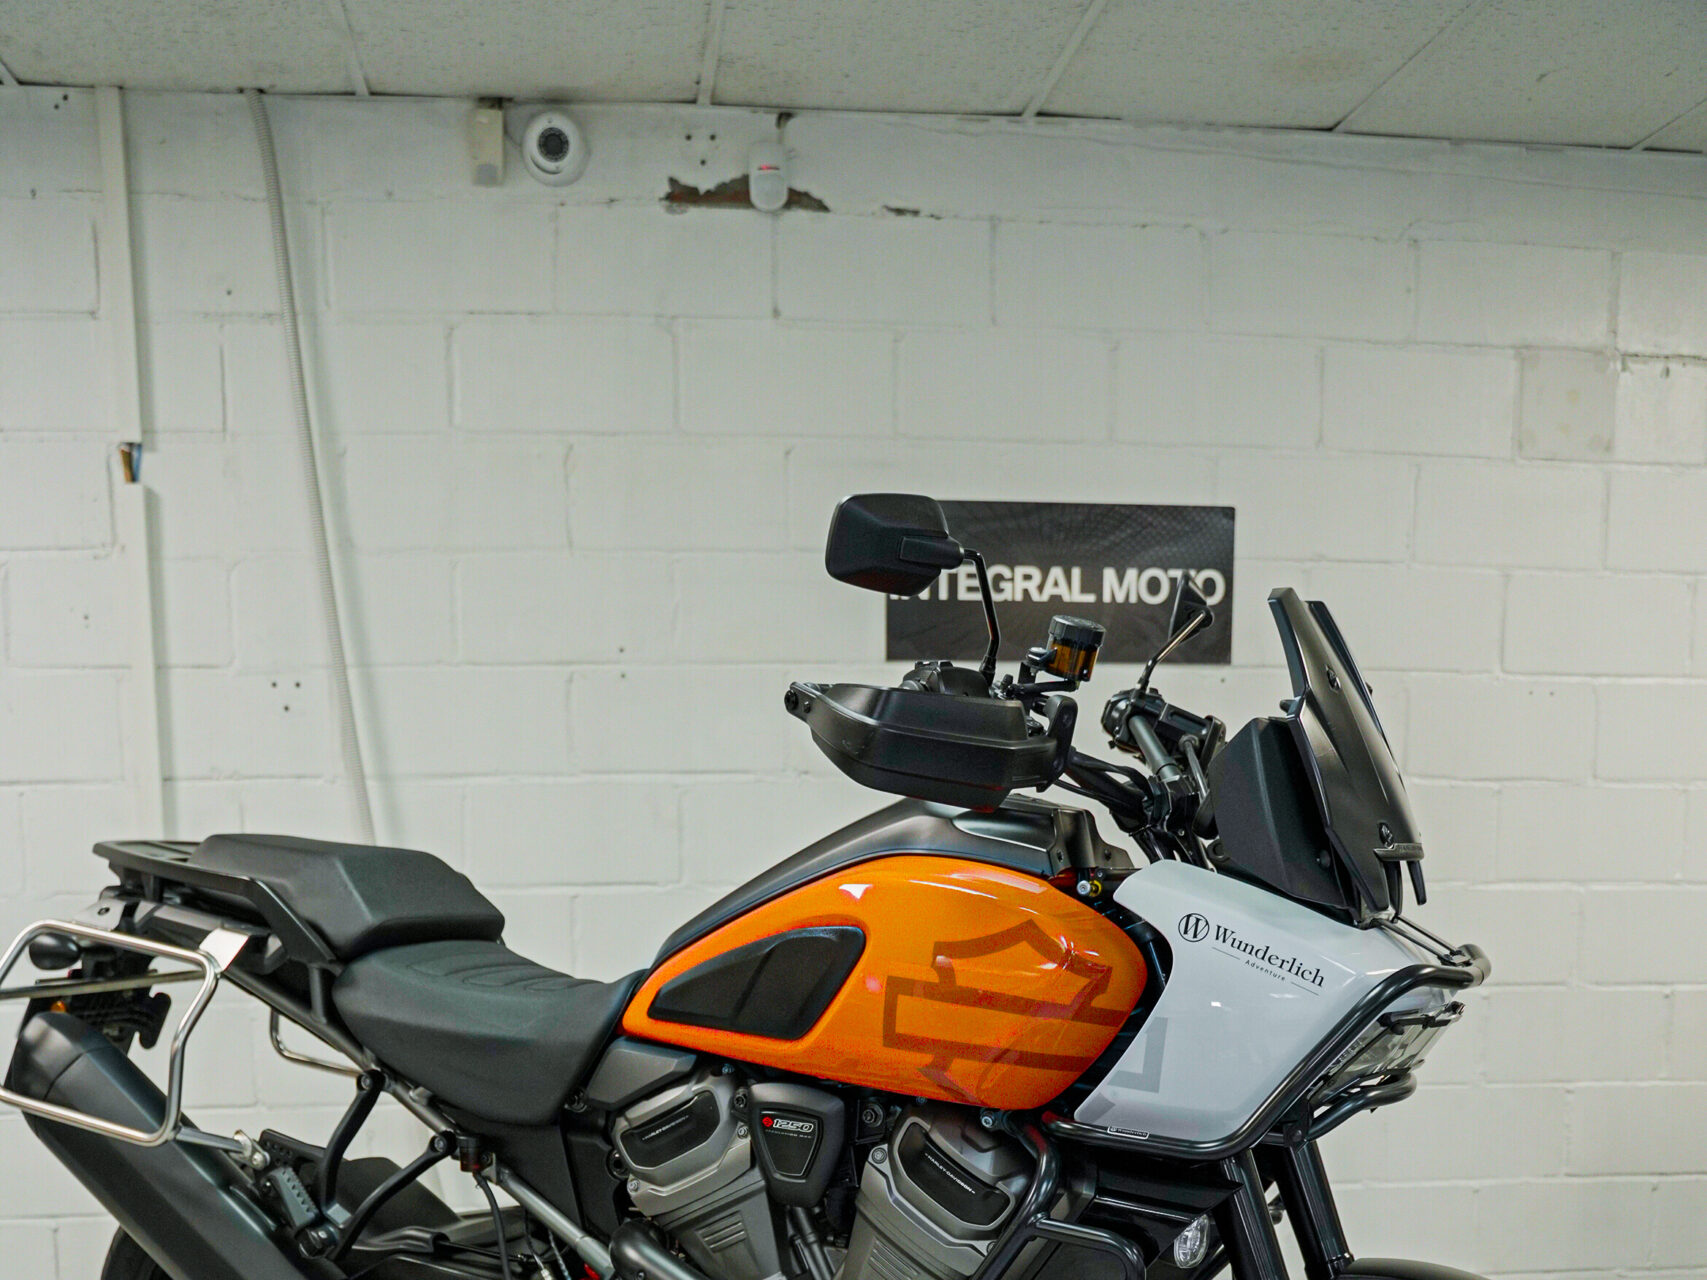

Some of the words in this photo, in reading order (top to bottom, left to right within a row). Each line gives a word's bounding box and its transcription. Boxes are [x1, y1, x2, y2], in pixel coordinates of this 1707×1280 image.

[889, 564, 1096, 603] TEGRAL
[1215, 925, 1325, 988] Wunderlich
[1245, 959, 1286, 981] Adventure
[773, 1118, 814, 1133] 1250
